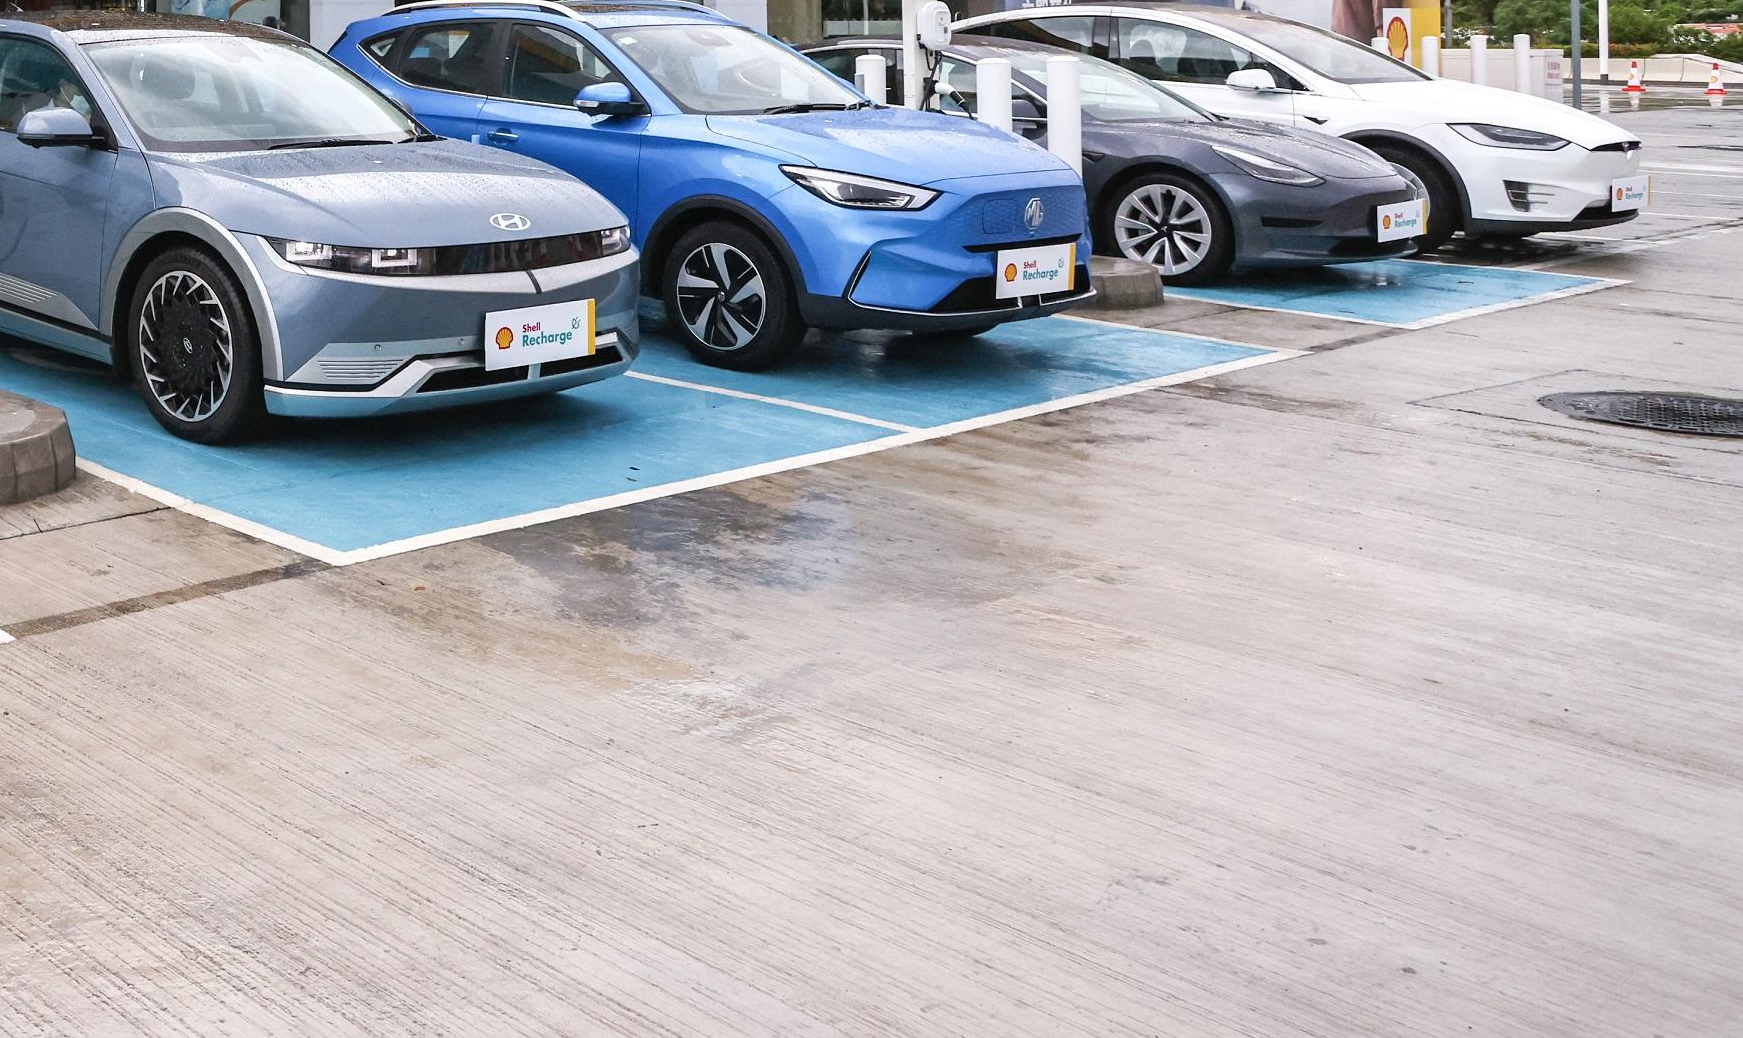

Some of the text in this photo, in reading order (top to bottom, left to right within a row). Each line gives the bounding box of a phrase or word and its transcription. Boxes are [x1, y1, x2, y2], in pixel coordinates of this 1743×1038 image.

[1023, 260, 1037, 269] Shell
[1023, 268, 1059, 281] Recharge
[522, 322, 541, 333] Shell
[522, 331, 573, 347] Recharge
